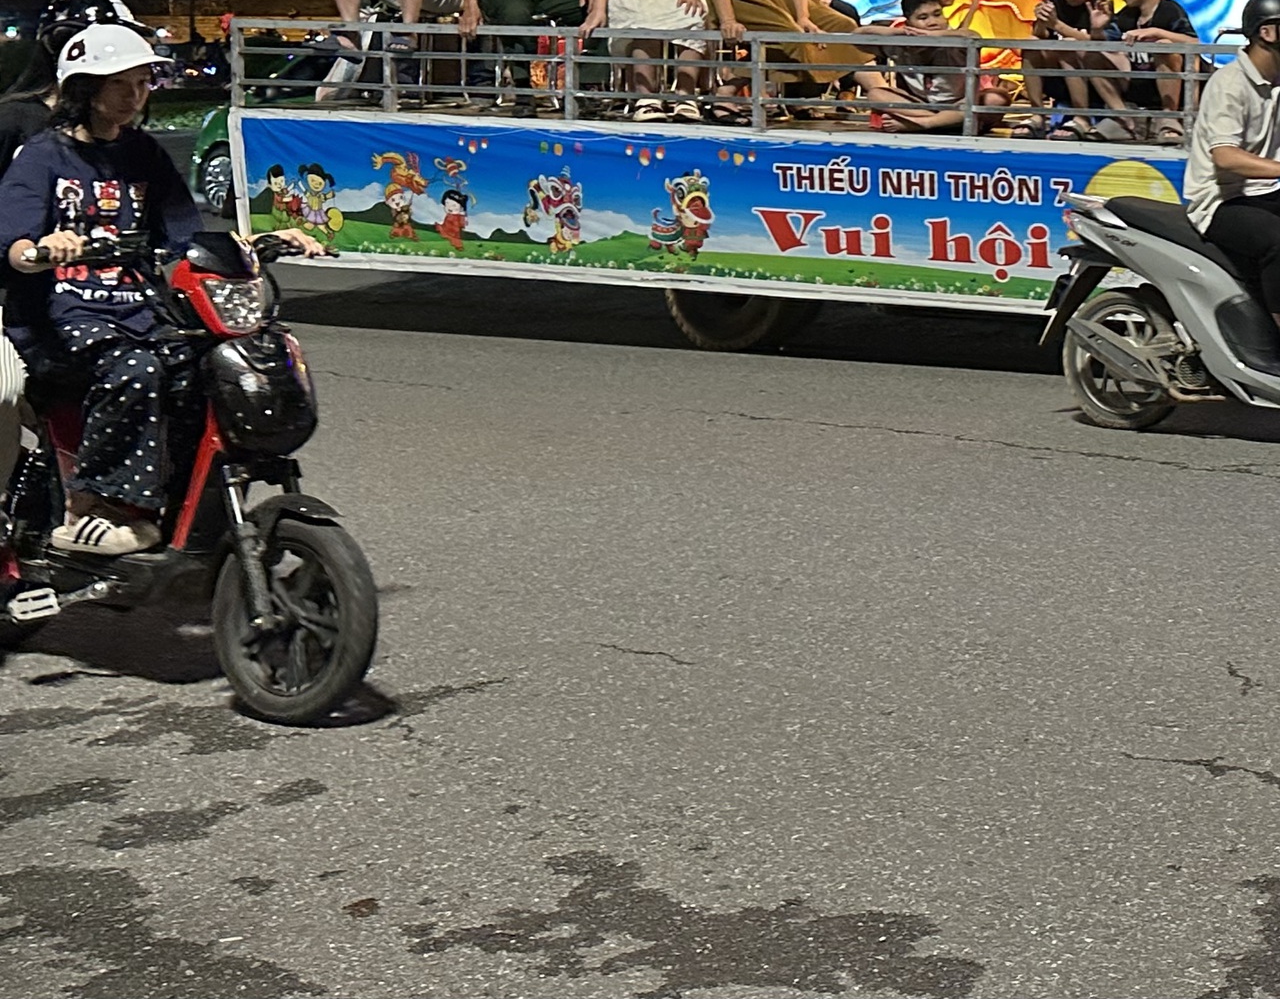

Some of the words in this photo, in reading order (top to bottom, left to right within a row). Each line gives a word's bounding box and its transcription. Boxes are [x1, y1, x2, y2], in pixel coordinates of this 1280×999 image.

[774, 157, 868, 194] THIẾU
[880, 169, 937, 198] NHI
[945, 168, 1041, 204] THÔN
[1053, 179, 1073, 206] 7
[754, 208, 896, 258] Vui
[925, 217, 1053, 281] hội
